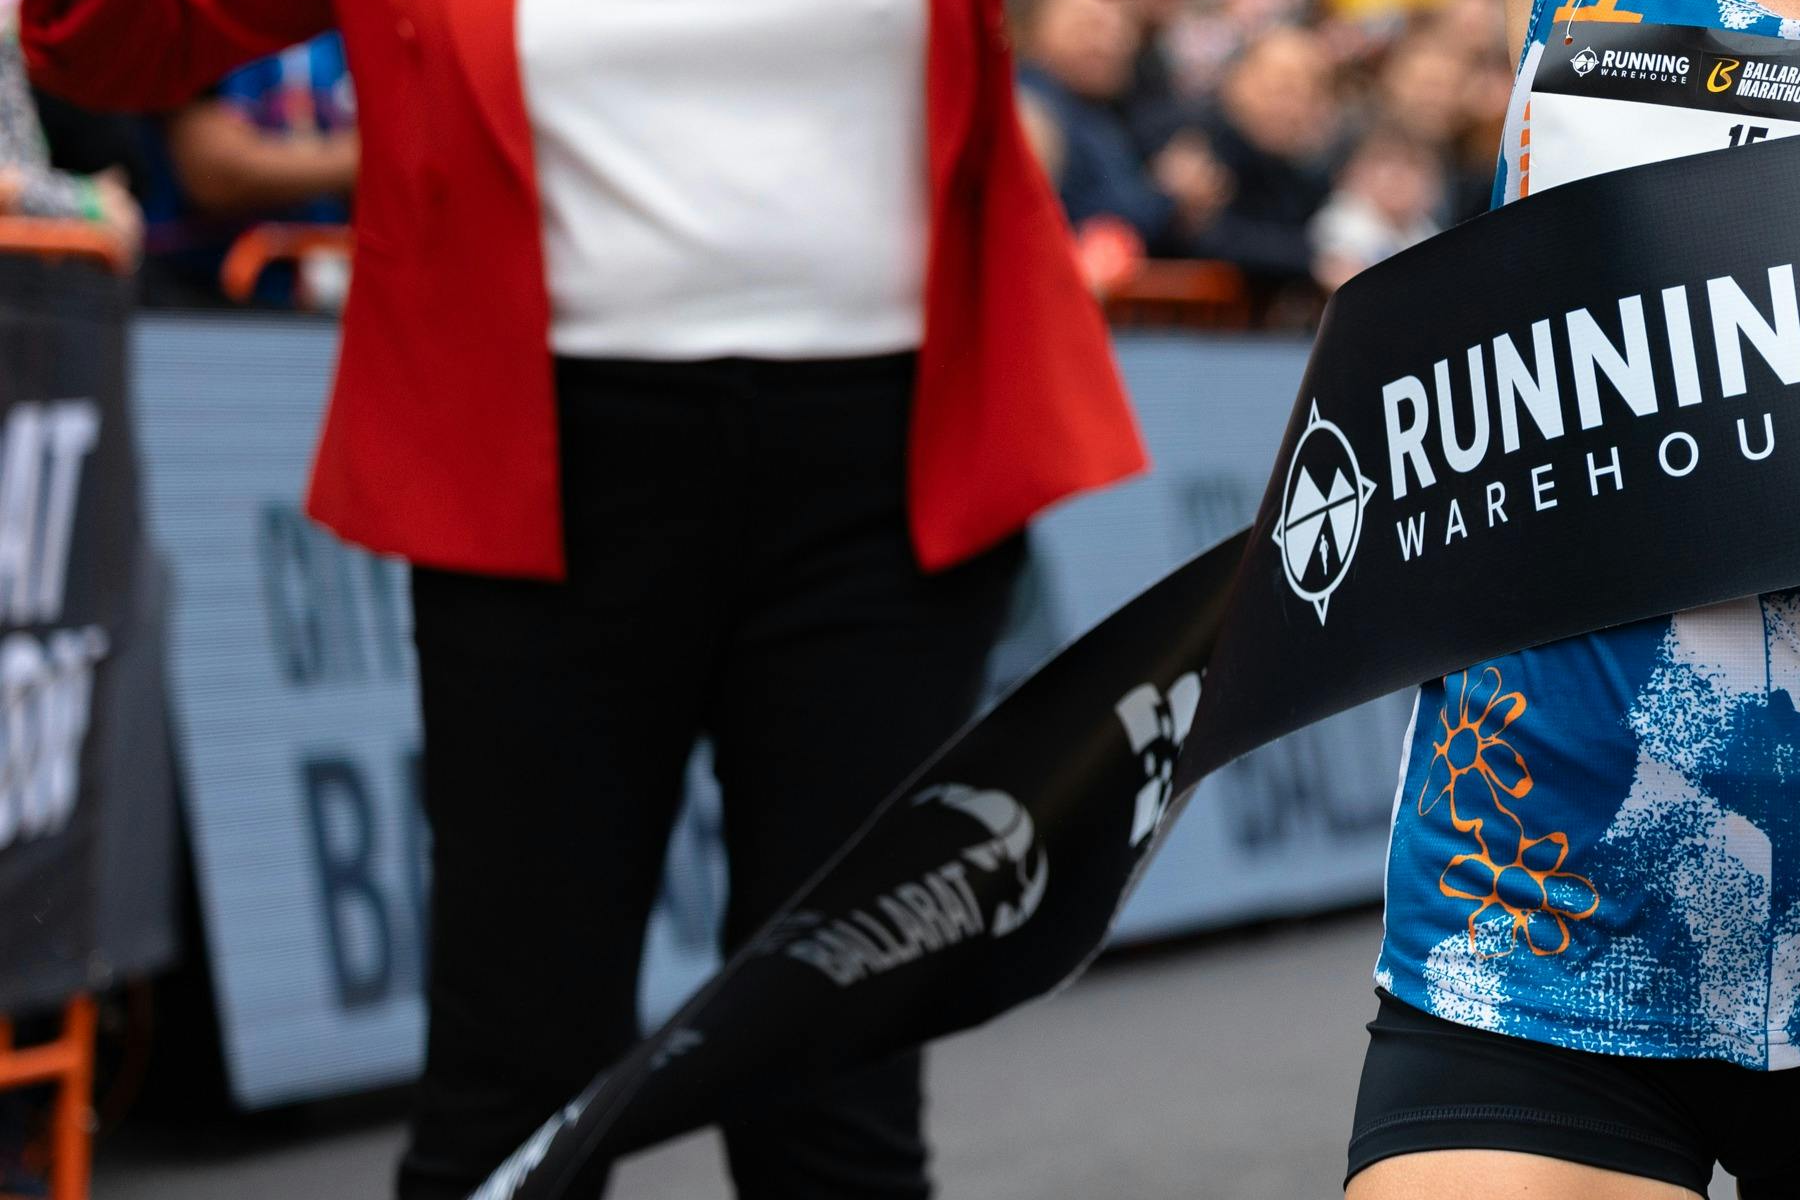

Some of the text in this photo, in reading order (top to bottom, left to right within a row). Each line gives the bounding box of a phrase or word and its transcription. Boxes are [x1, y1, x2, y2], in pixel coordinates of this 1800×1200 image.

[1602, 50, 1691, 76] RUNNING
[1601, 68, 1688, 85] WAREHOUSE
[787, 860, 986, 987] BALLARAT
